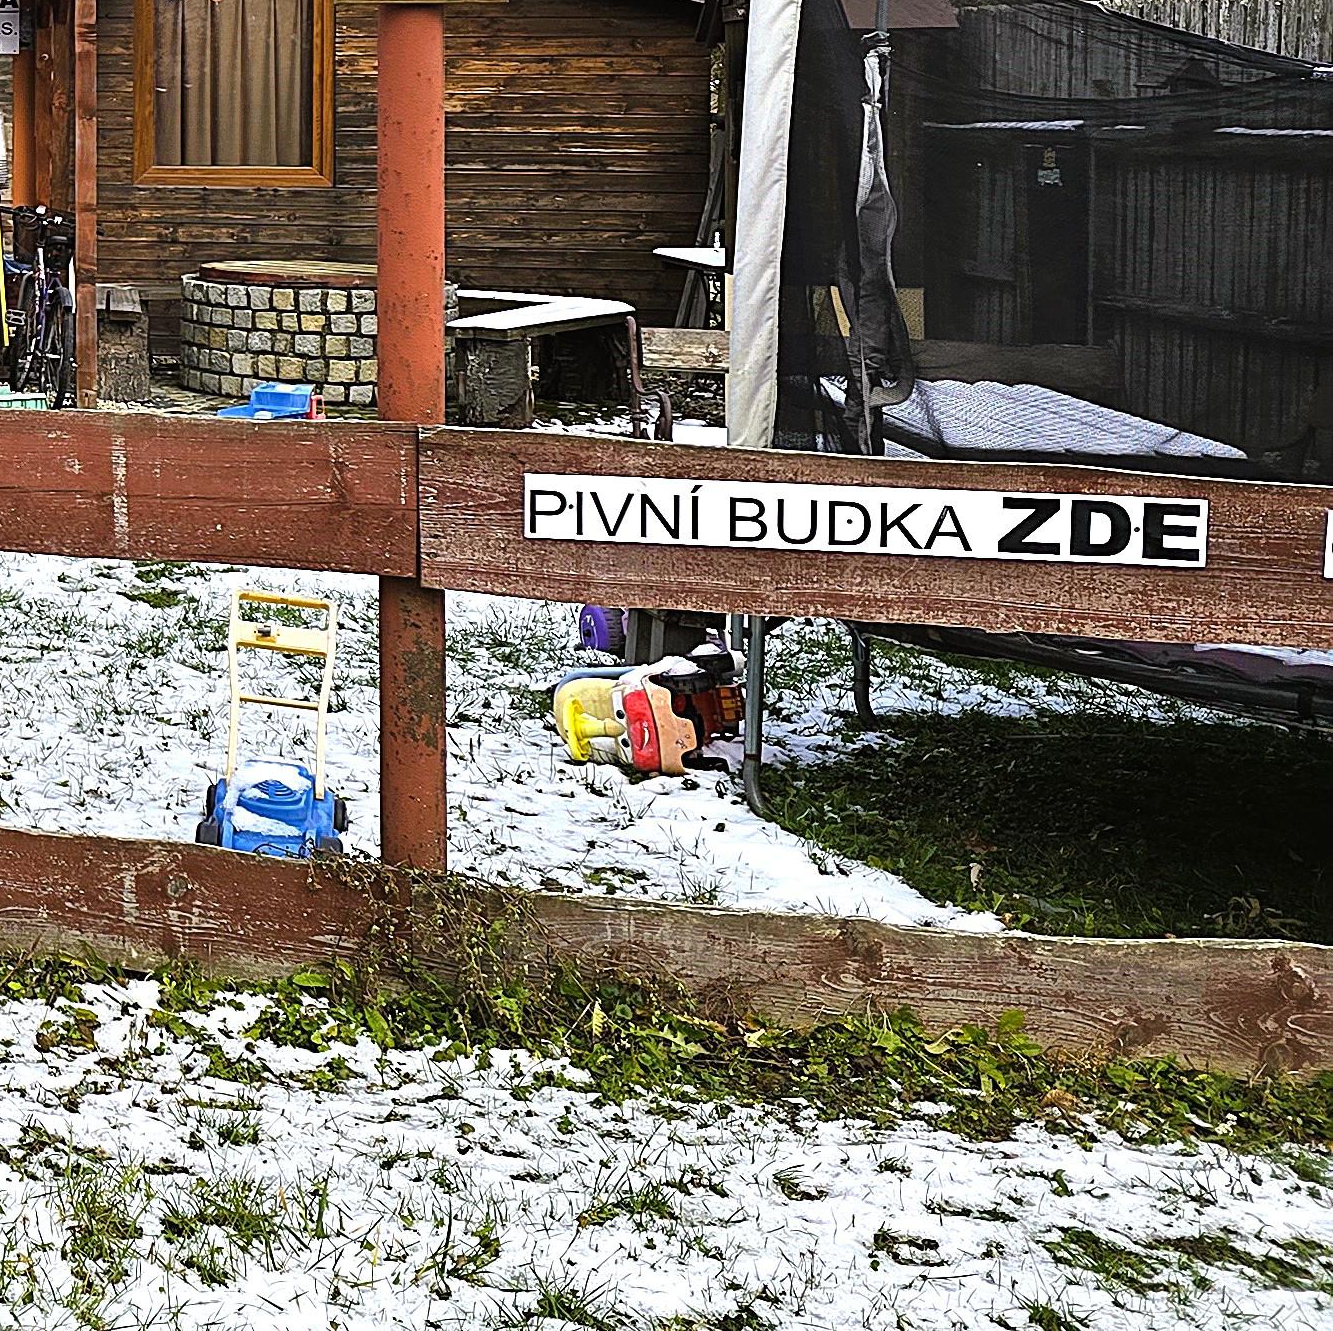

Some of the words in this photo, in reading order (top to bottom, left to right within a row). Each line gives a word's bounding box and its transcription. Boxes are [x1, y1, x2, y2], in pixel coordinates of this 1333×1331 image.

[529, 485, 703, 540] PIVNÍ
[729, 497, 973, 552] BUDKA
[997, 497, 1201, 562] ZDE
